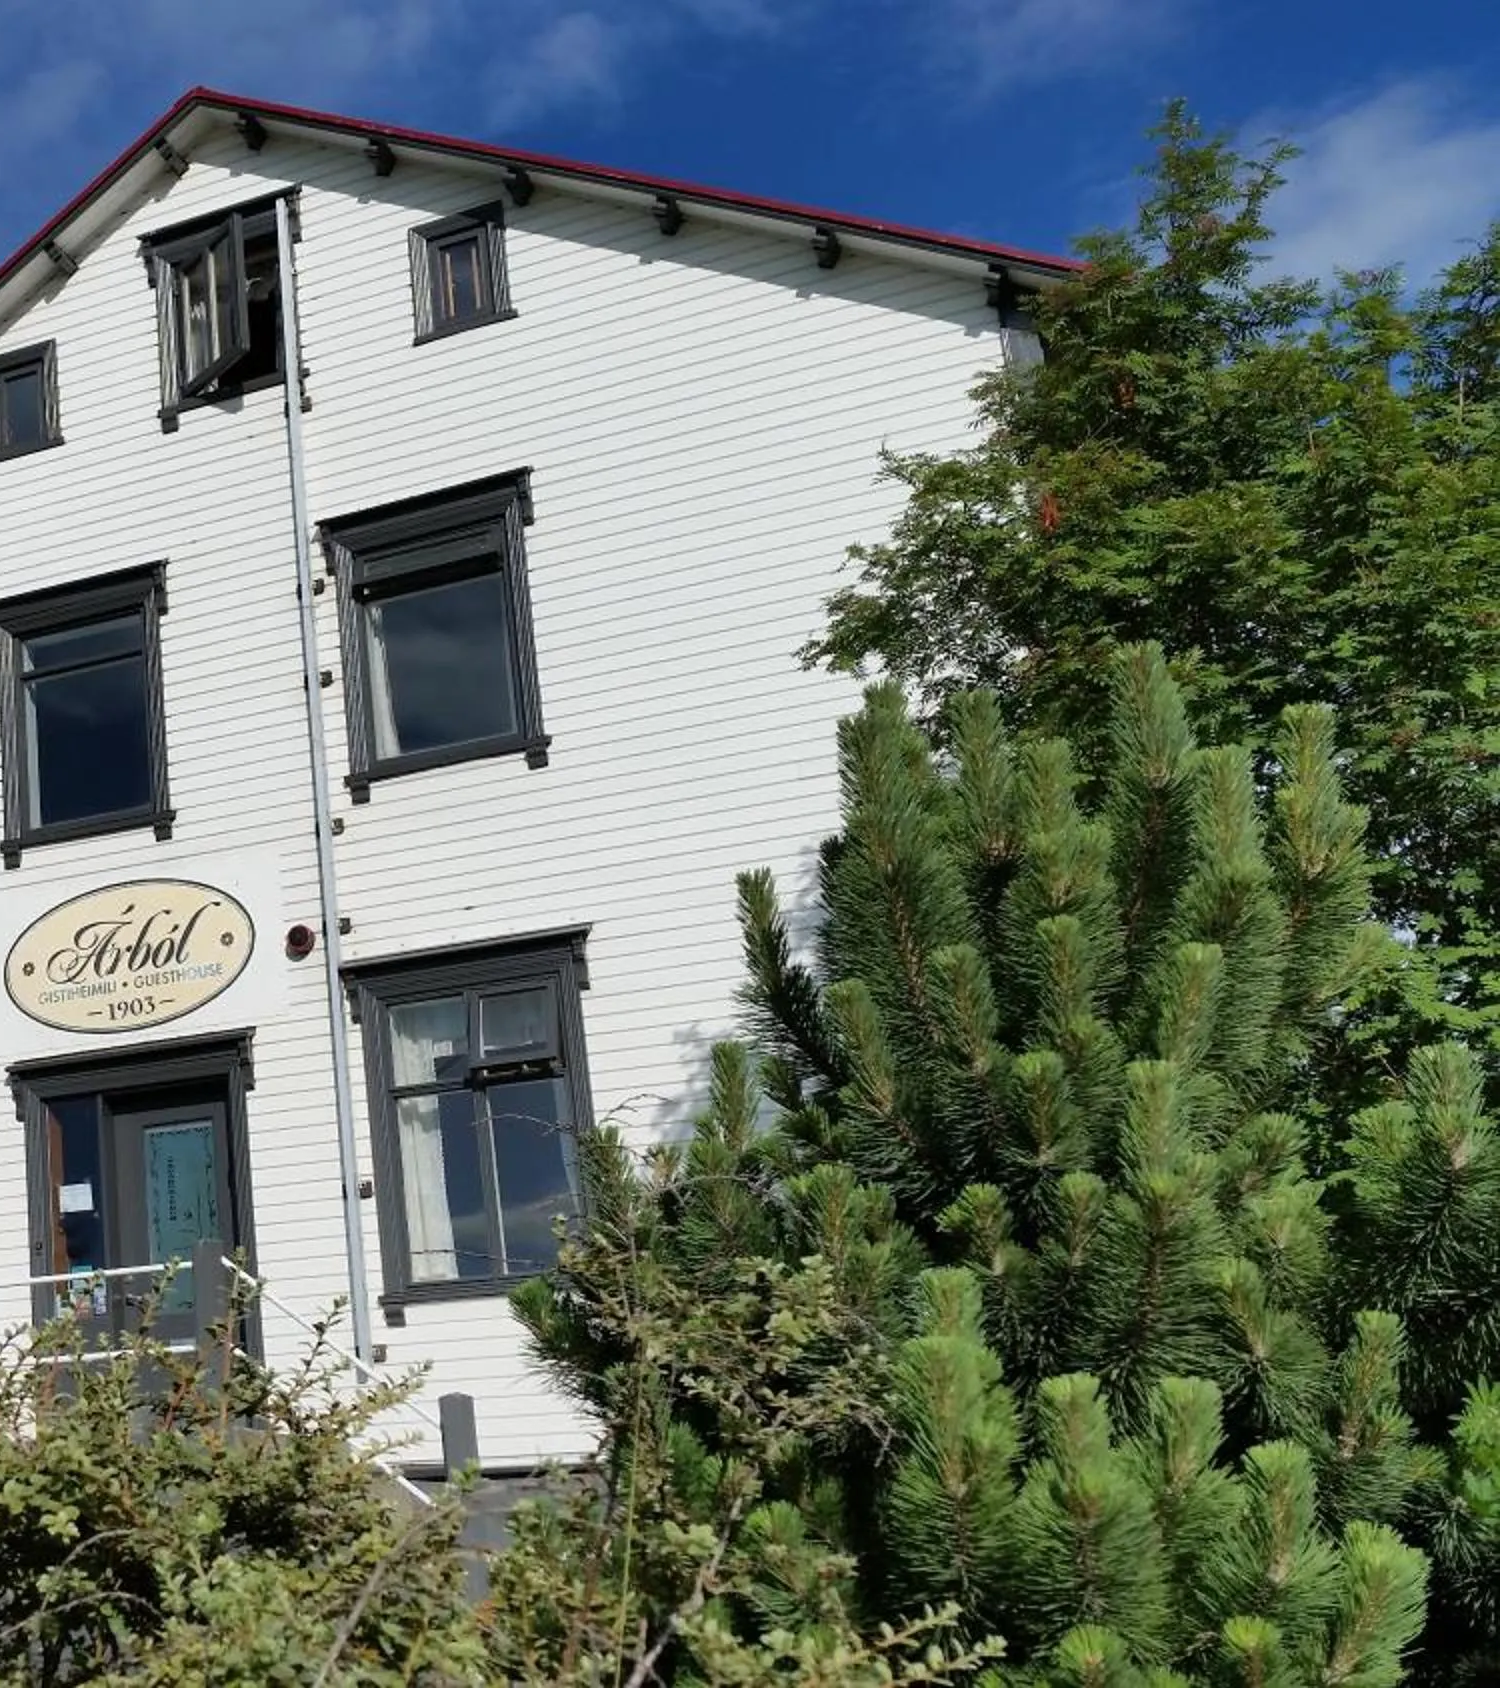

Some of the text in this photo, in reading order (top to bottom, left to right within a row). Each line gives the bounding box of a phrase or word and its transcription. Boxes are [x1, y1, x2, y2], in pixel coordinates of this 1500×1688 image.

[46, 902, 220, 984] Árból
[38, 962, 224, 1005] GISTIHEIMILI GUESTHOUSE
[108, 996, 155, 1021] 1903
